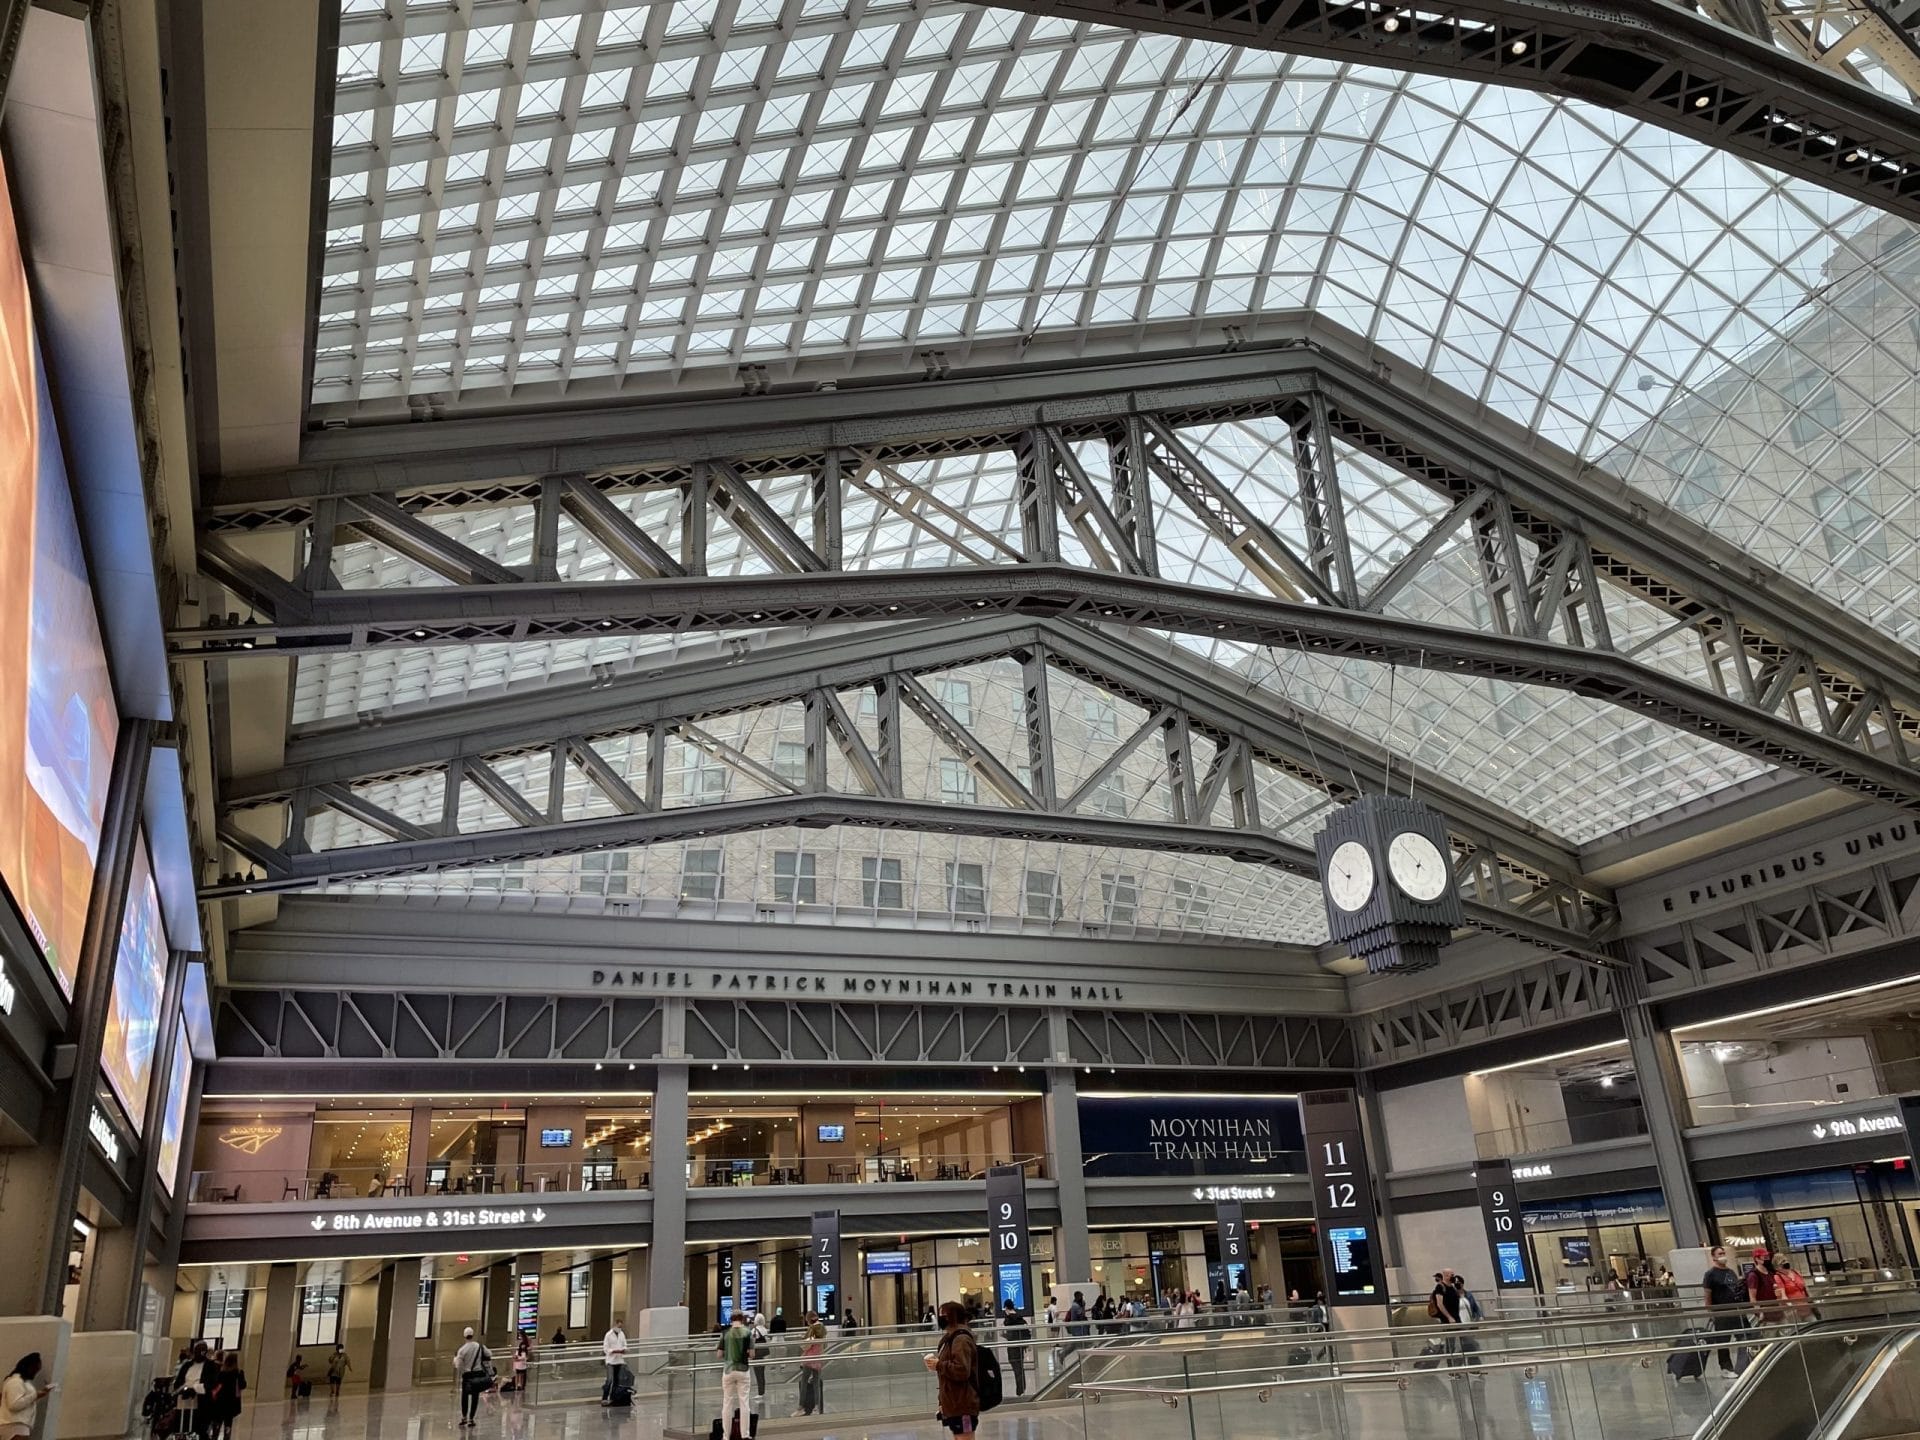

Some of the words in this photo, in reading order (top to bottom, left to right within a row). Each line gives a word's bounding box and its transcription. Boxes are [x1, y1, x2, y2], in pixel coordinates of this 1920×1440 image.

[1663, 897, 1674, 912] E
[1689, 851, 1826, 904] PLURIBUS
[1845, 819, 1920, 855] UNU
[592, 970, 694, 988] DANIEL
[712, 973, 827, 992] PATRICK
[843, 977, 974, 995] MOYNIHAN
[987, 982, 1057, 998] TRAIN
[1071, 985, 1125, 1001] HALL
[1149, 1118, 1271, 1137] MOYNIHAN
[1830, 1120, 1857, 1136] 9th
[1149, 1141, 1217, 1160] TRAIN
[1224, 1141, 1278, 1159] HALL
[1323, 1141, 1348, 1167] 11
[1512, 1164, 1552, 1179] TRAK
[1206, 1187, 1229, 1201] 31st
[1230, 1186, 1263, 1200] Street
[1328, 1183, 1357, 1209] 12
[1492, 1191, 1504, 1207] 9
[333, 1215, 360, 1230] 8th
[363, 1213, 423, 1229] Avenue
[426, 1212, 438, 1227] &
[442, 1210, 475, 1227] 31st
[478, 1208, 526, 1225] Street
[1001, 1203, 1012, 1221] 9
[1559, 1211, 1583, 1220] Ticketing
[1226, 1222, 1236, 1235] 7
[1495, 1216, 1514, 1232] 10
[820, 1238, 830, 1253] 7
[999, 1232, 1019, 1252] 10
[1229, 1242, 1239, 1256] 8
[723, 1257, 732, 1270] 5
[820, 1260, 830, 1275] 8
[723, 1275, 732, 1289] 6
